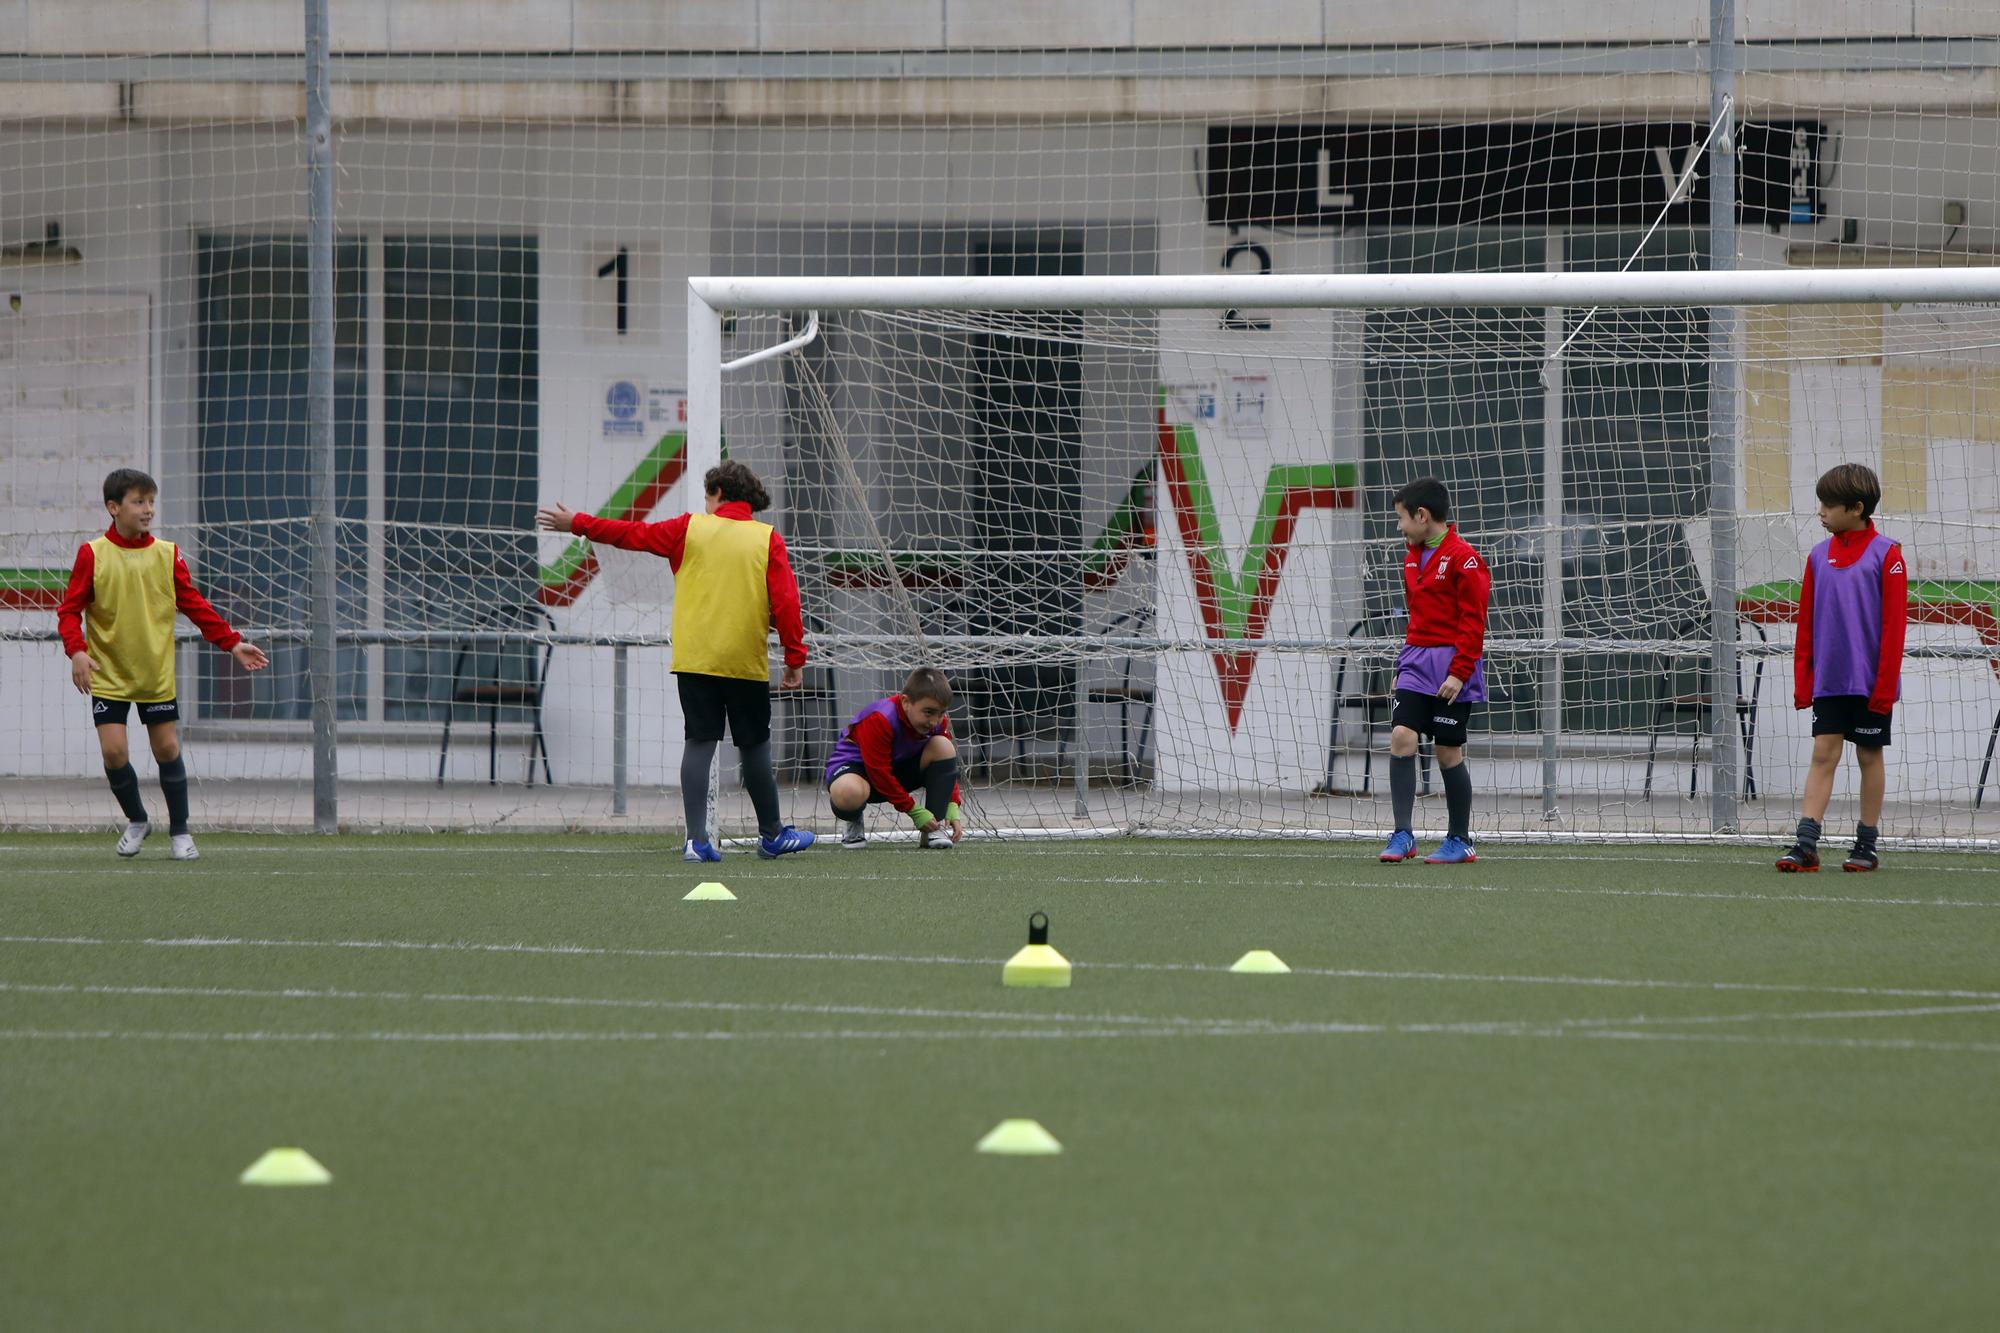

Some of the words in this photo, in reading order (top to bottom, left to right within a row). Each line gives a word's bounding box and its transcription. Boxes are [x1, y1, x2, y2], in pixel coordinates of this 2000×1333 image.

[1317, 148, 1354, 207] L
[1654, 146, 1701, 205] V
[598, 246, 627, 335] 1
[1220, 241, 1271, 330] 2
